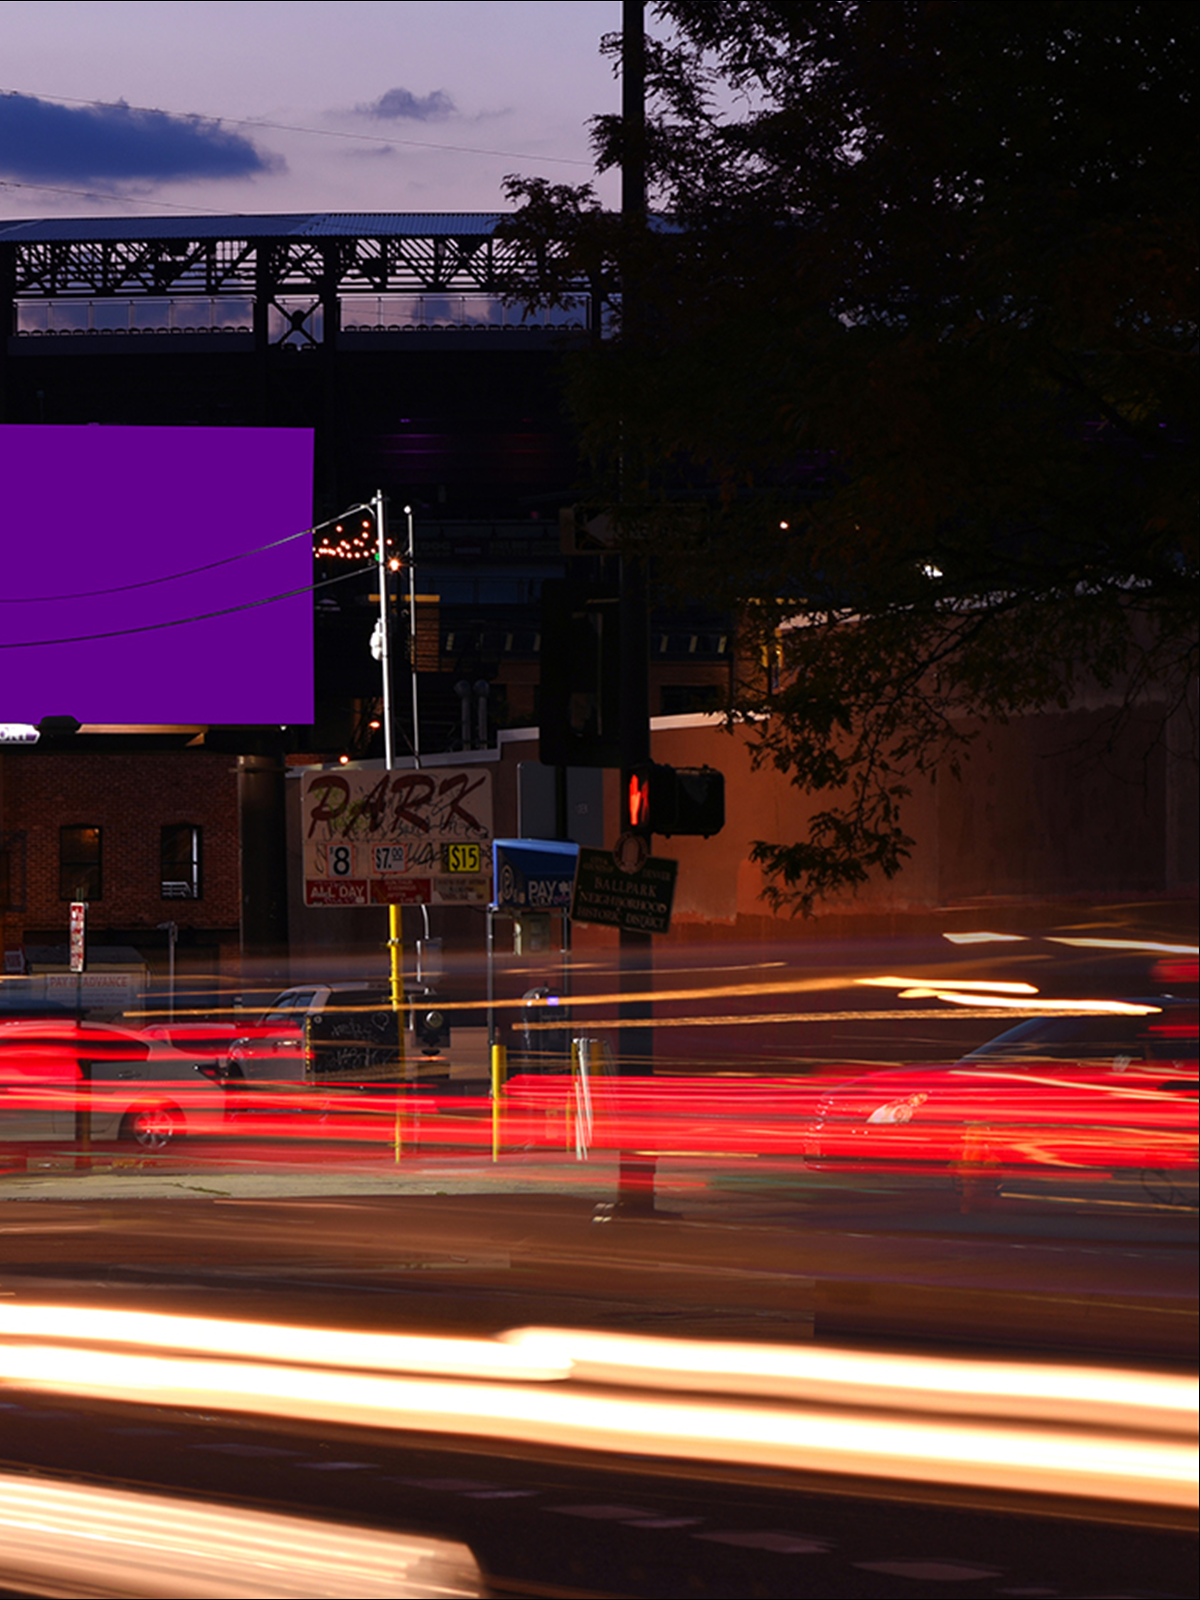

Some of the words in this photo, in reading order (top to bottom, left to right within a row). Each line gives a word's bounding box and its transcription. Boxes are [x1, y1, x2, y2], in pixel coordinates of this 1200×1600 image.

[308, 773, 486, 838] PARK
[451, 848, 477, 870] $15
[310, 885, 336, 898] ALL
[339, 885, 365, 897] DAY
[528, 880, 557, 898] PAY
[594, 876, 657, 897] BALLPARK
[580, 890, 667, 914] NEIGHBORHOOD
[50, 977, 68, 987] PAY
[83, 976, 127, 987] ADVANCE
